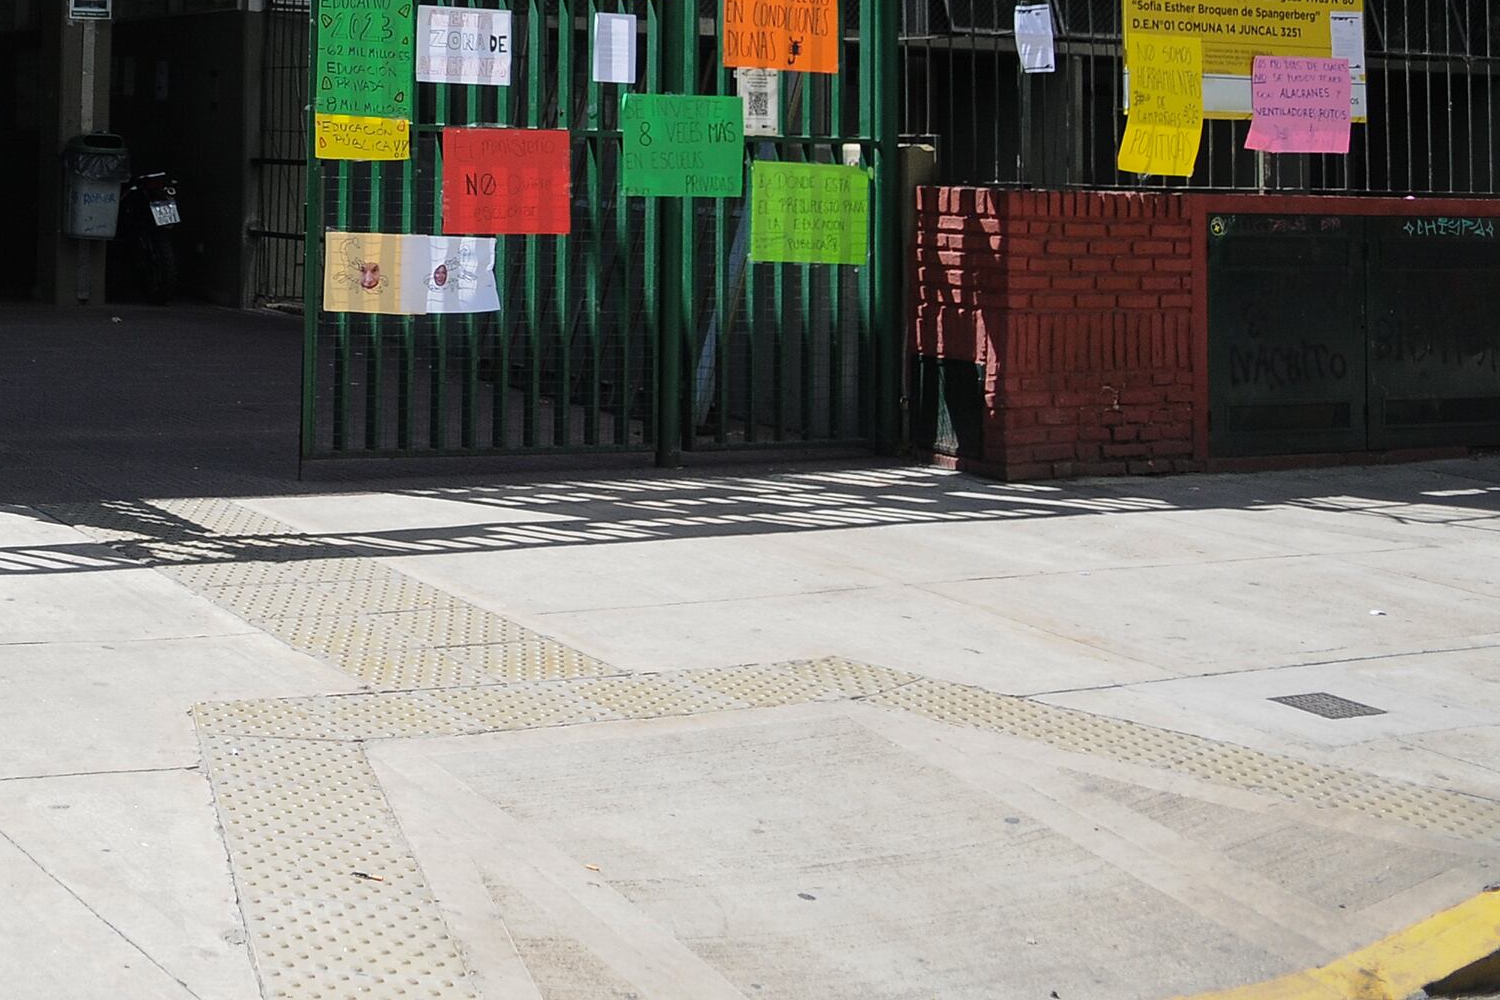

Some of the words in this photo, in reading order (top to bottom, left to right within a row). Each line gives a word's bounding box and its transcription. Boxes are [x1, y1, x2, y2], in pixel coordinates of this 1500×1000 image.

[1165, 2, 1195, 14] Esther
[1198, 4, 1239, 18] Broquen
[1241, 7, 1253, 17] de
[726, 0, 744, 23] EN
[753, 2, 829, 37] CONDICIONES
[1178, 21, 1223, 34] COMUNA
[1226, 24, 1237, 34] 14
[1239, 26, 1278, 38] JUNCAL
[1280, 27, 1302, 38] 3251
[430, 29, 486, 51] ZONA
[489, 35, 507, 53] DE
[727, 30, 777, 62] DIGNAS
[348, 46, 366, 58] MIL
[1136, 41, 1155, 62] NO
[1162, 45, 1192, 65] SOMOS
[1306, 61, 1318, 71] DE
[334, 76, 384, 92] PRIVADA
[1254, 73, 1267, 81] NO
[1279, 87, 1330, 99] ALACRANES
[340, 99, 361, 111] MIL
[625, 99, 644, 120] SE
[322, 121, 393, 136] EDUCACIÓN
[640, 121, 652, 146] 8
[665, 121, 703, 143] VECES
[708, 120, 736, 143] MÁS
[625, 152, 643, 169] EN
[651, 151, 704, 170] ESCUELAS
[685, 174, 735, 193] PRIVADAS
[758, 200, 769, 215] EL
[767, 218, 780, 230] LA
